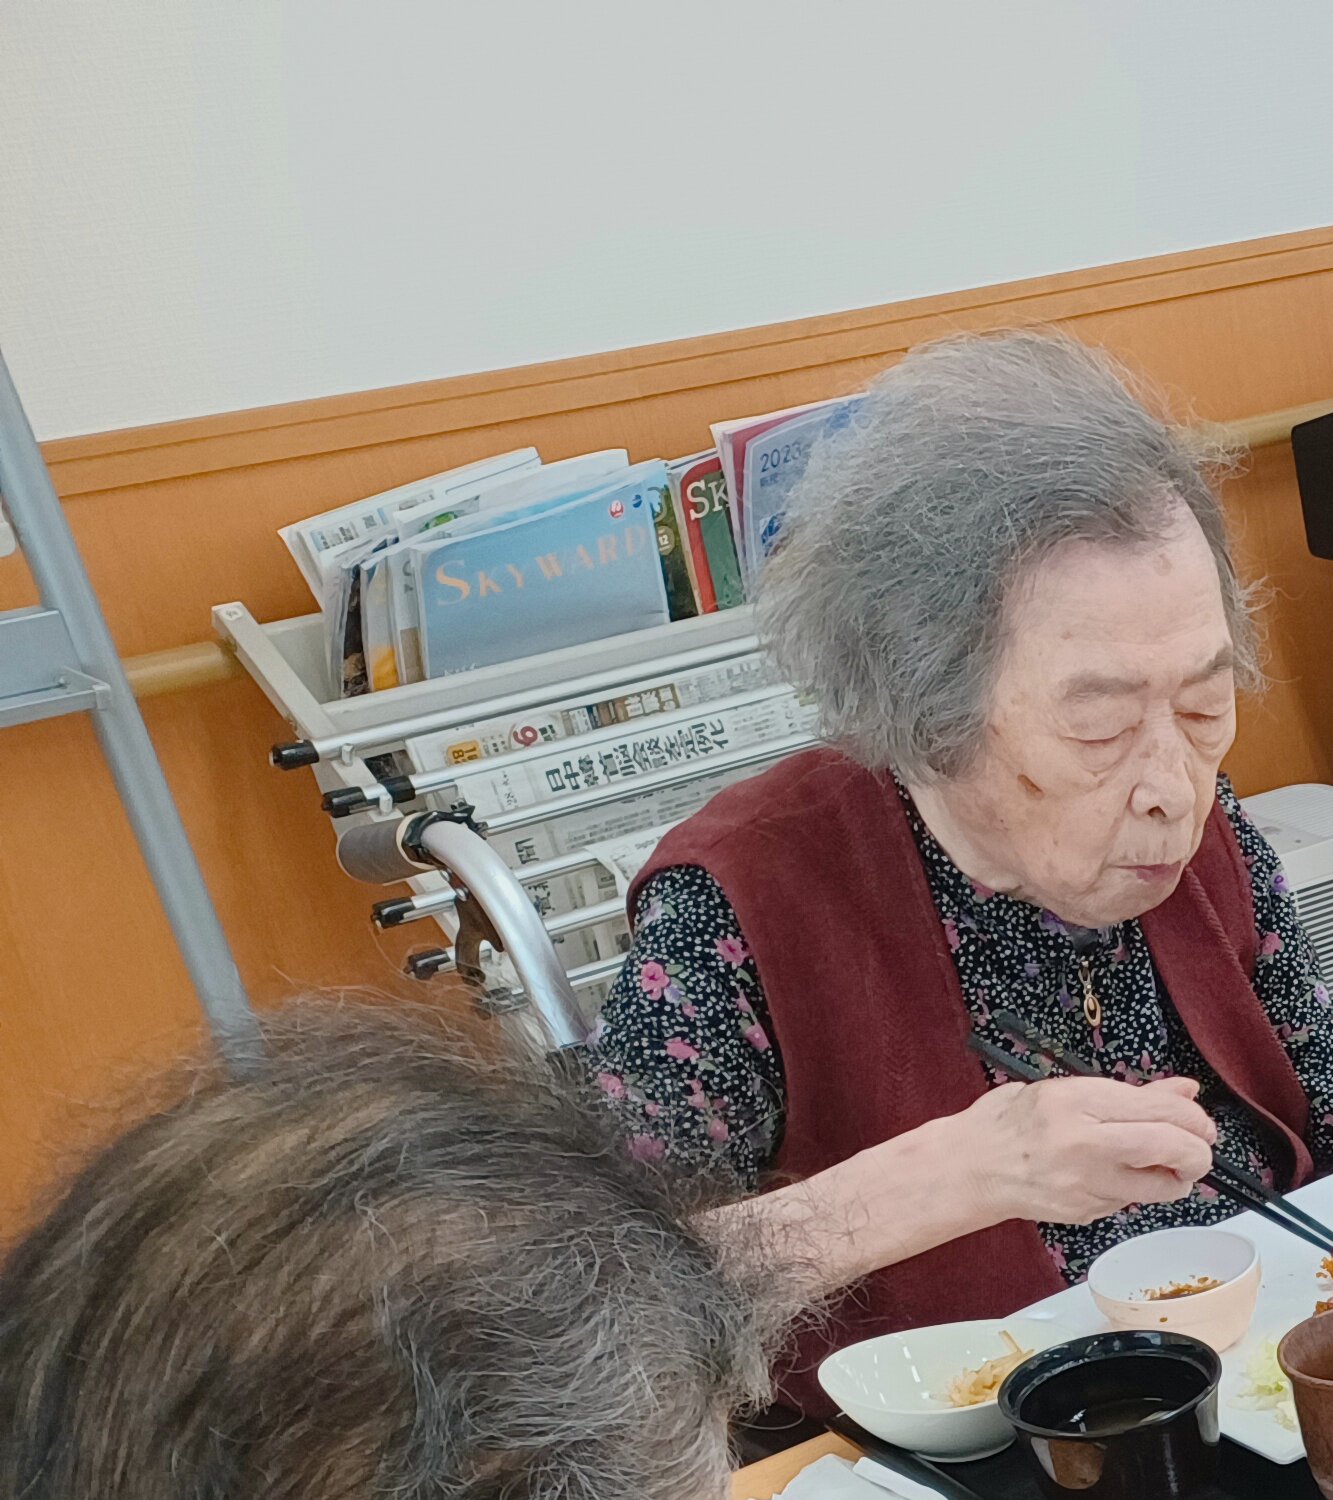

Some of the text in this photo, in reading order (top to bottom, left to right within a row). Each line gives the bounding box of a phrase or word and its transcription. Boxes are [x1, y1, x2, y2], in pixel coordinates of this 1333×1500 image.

[434, 526, 647, 606] SKYWARD
[545, 717, 730, 793] 日中韓首脳会談を定例化
